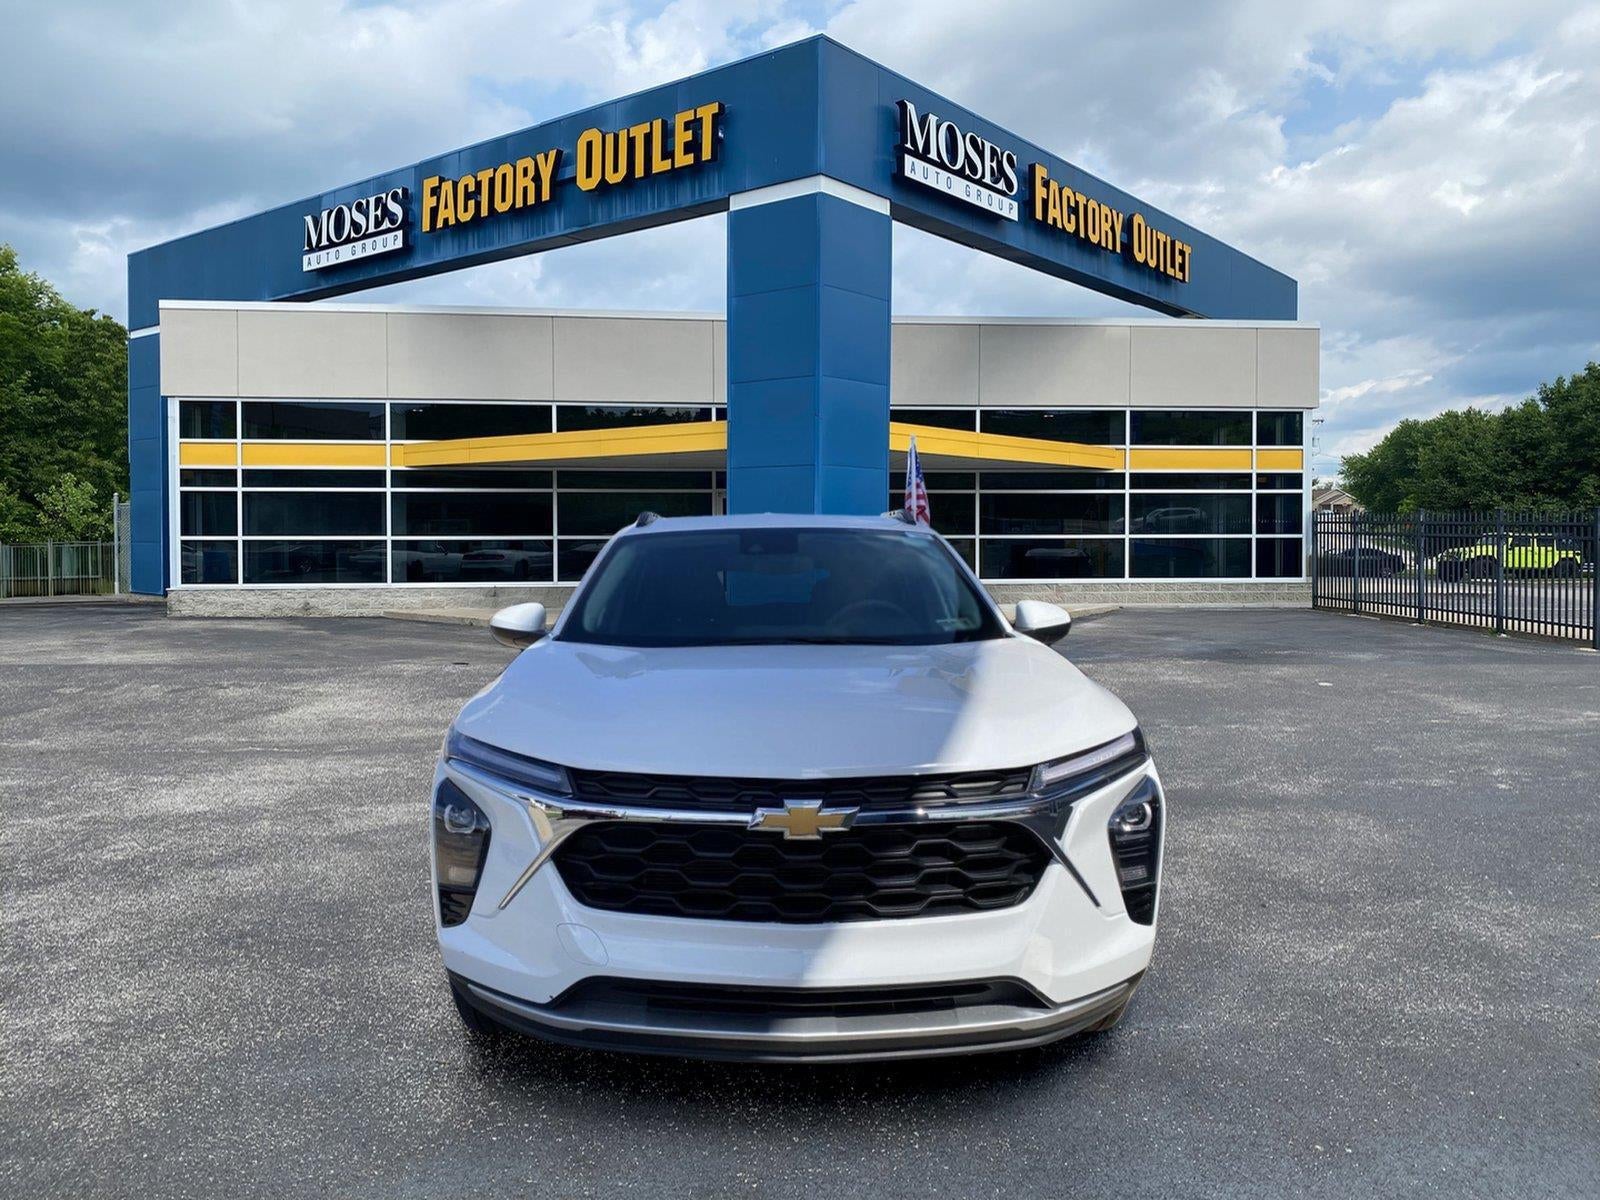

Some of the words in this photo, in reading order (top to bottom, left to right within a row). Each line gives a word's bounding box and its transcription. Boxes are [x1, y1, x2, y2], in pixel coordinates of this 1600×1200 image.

[422, 148, 559, 232] FACTORY
[576, 102, 720, 191] OUTLET
[904, 100, 1018, 196] MOSES
[909, 161, 953, 190] AUTO
[965, 184, 1015, 214] GROUP
[303, 188, 405, 251] MOSES
[306, 250, 342, 268] AUTO
[351, 235, 400, 257] GROUP
[1034, 163, 1124, 253] FACTORY
[1133, 212, 1192, 283] OUTLET
